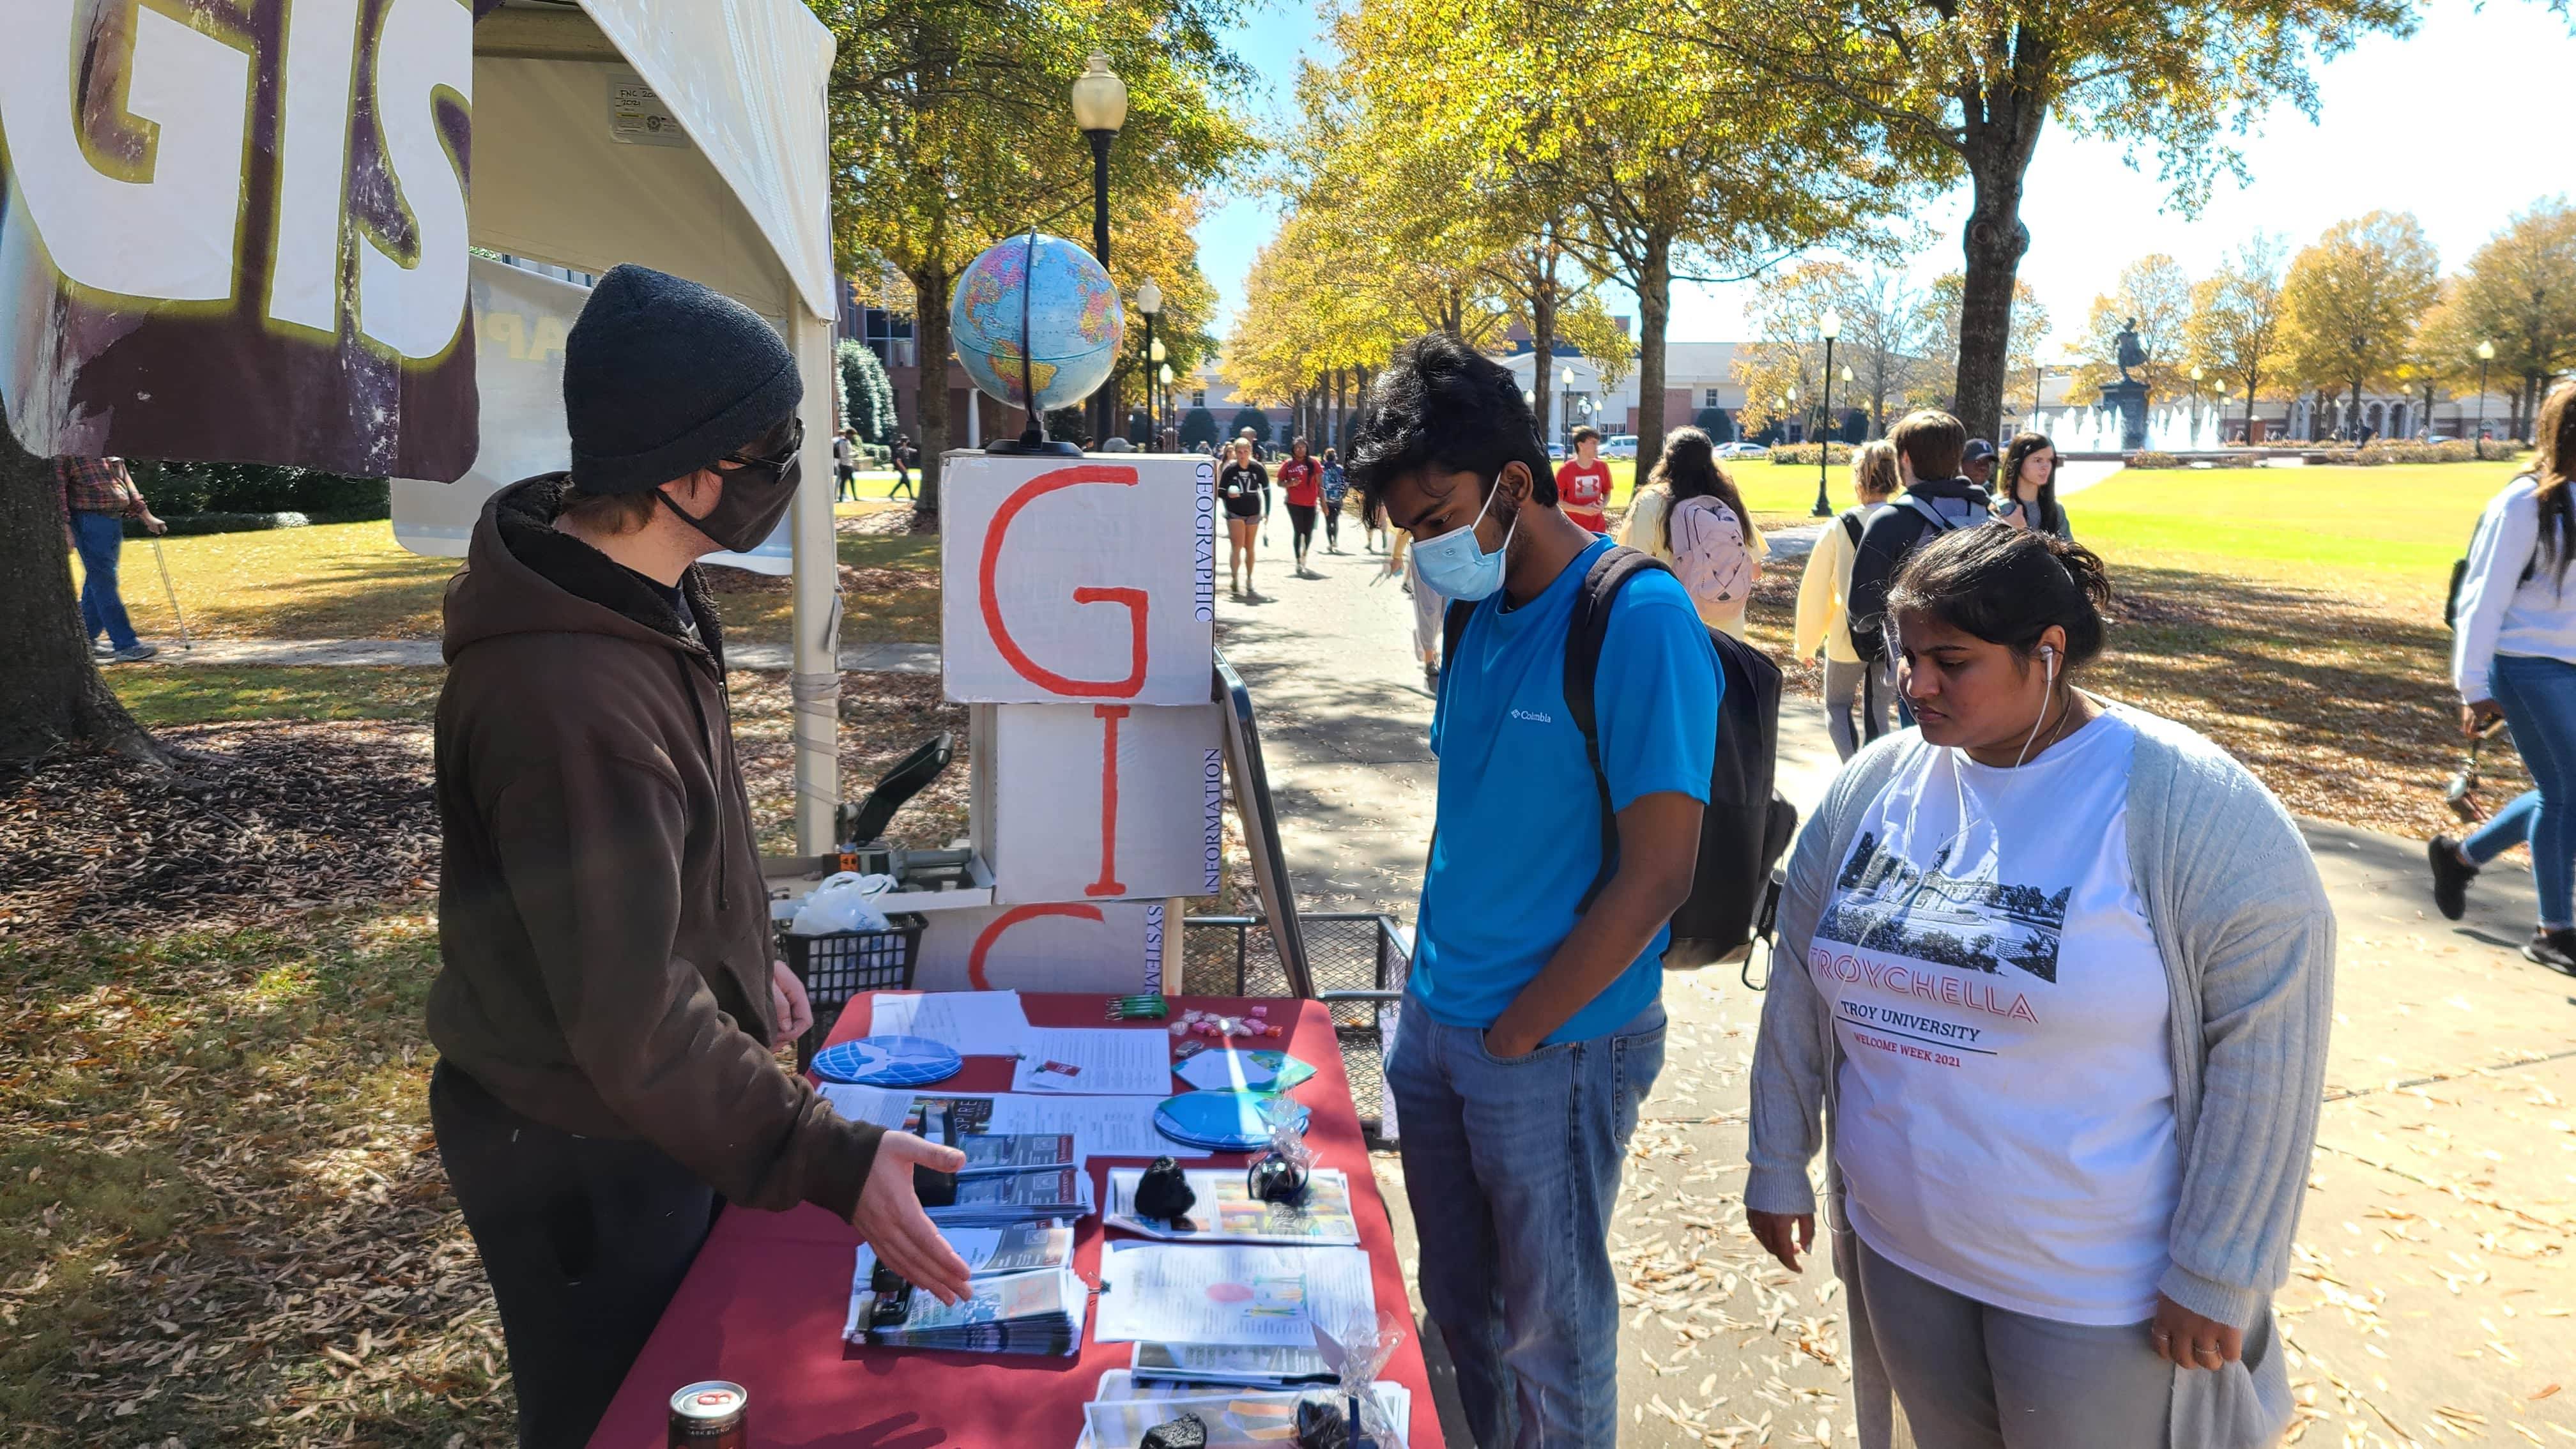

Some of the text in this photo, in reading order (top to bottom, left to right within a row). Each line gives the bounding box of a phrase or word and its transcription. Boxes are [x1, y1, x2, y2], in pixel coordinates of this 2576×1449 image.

[0, 0, 471, 359] GIS
[979, 465, 1148, 699] G
[1195, 463, 1213, 623] GEOGRAPHIC
[1841, 1000, 1981, 1042] TROY UNIVERSITY
[1854, 1032, 1961, 1068] WELCOME WEEK 2021
